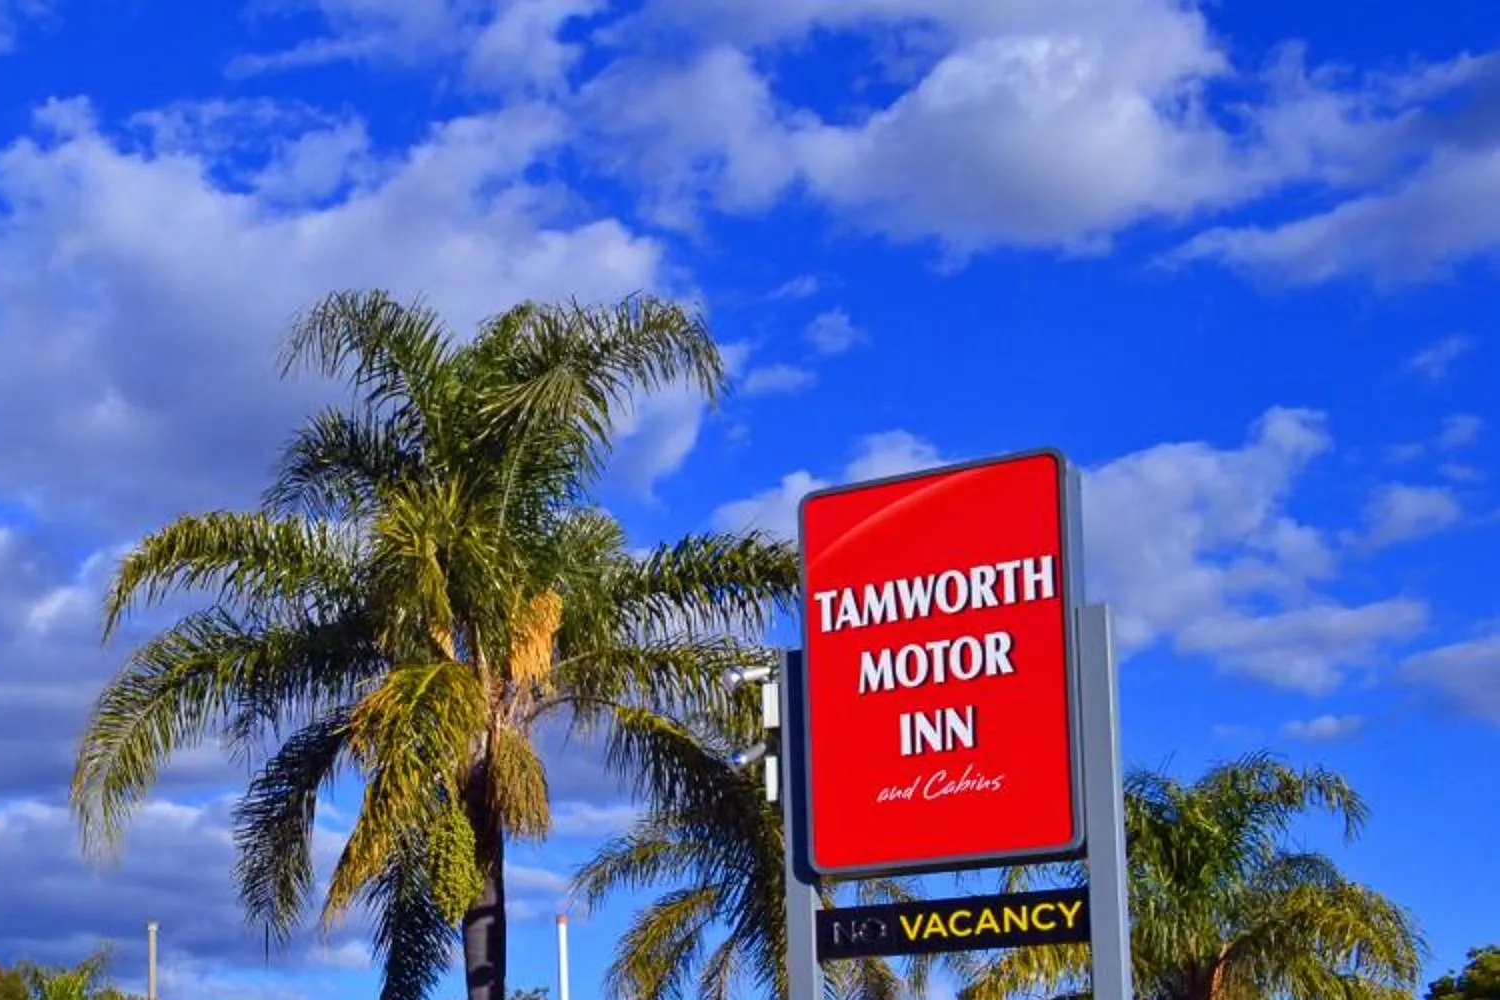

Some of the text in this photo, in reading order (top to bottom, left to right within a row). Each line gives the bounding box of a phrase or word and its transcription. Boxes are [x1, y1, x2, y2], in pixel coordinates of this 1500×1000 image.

[814, 555, 1055, 632] TAMWORTH
[858, 632, 1015, 694] MOTOR
[899, 705, 977, 756] INN
[876, 763, 1005, 803] and Cabins
[833, 901, 1083, 945] NO VACANCY
